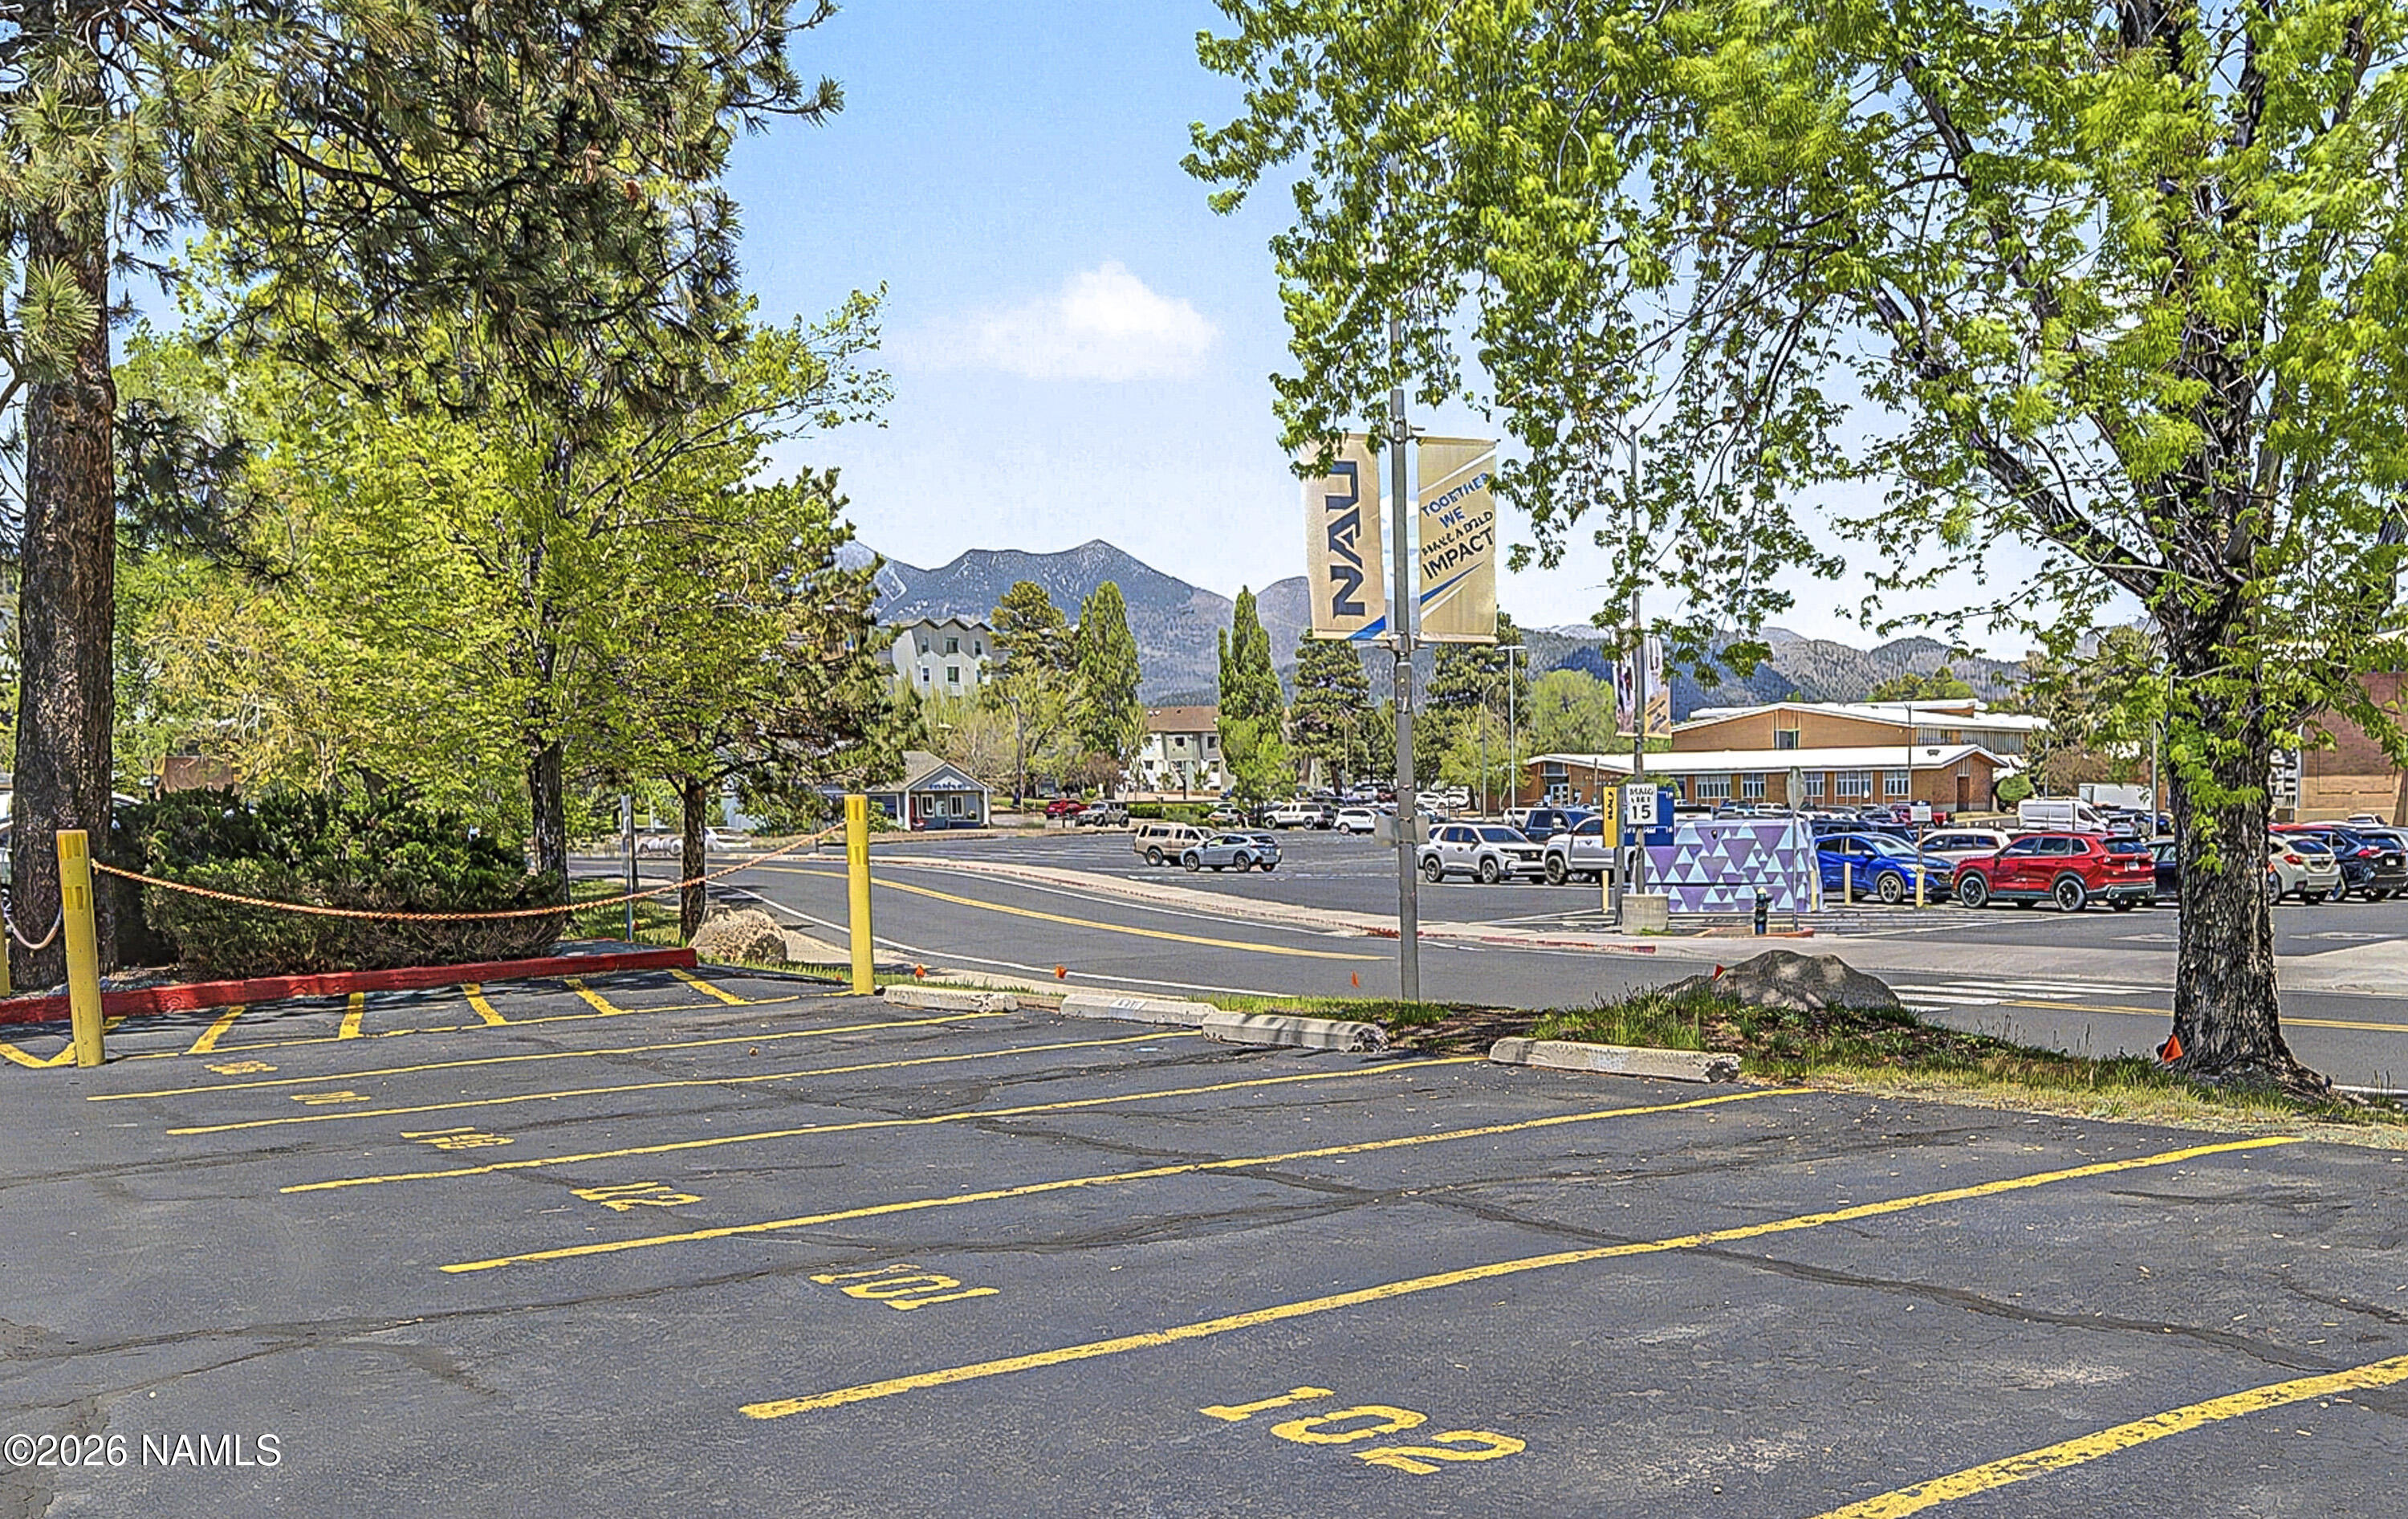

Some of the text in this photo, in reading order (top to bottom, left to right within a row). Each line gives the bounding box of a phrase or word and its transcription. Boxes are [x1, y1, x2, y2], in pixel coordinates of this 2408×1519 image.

[1325, 461, 1365, 618] NAU
[1439, 506, 1466, 528] WE
[1422, 527, 1493, 580] IMPACT
[1632, 804, 1651, 820] 15
[809, 1263, 1001, 1311] 101
[1199, 1386, 1526, 1476] 102
